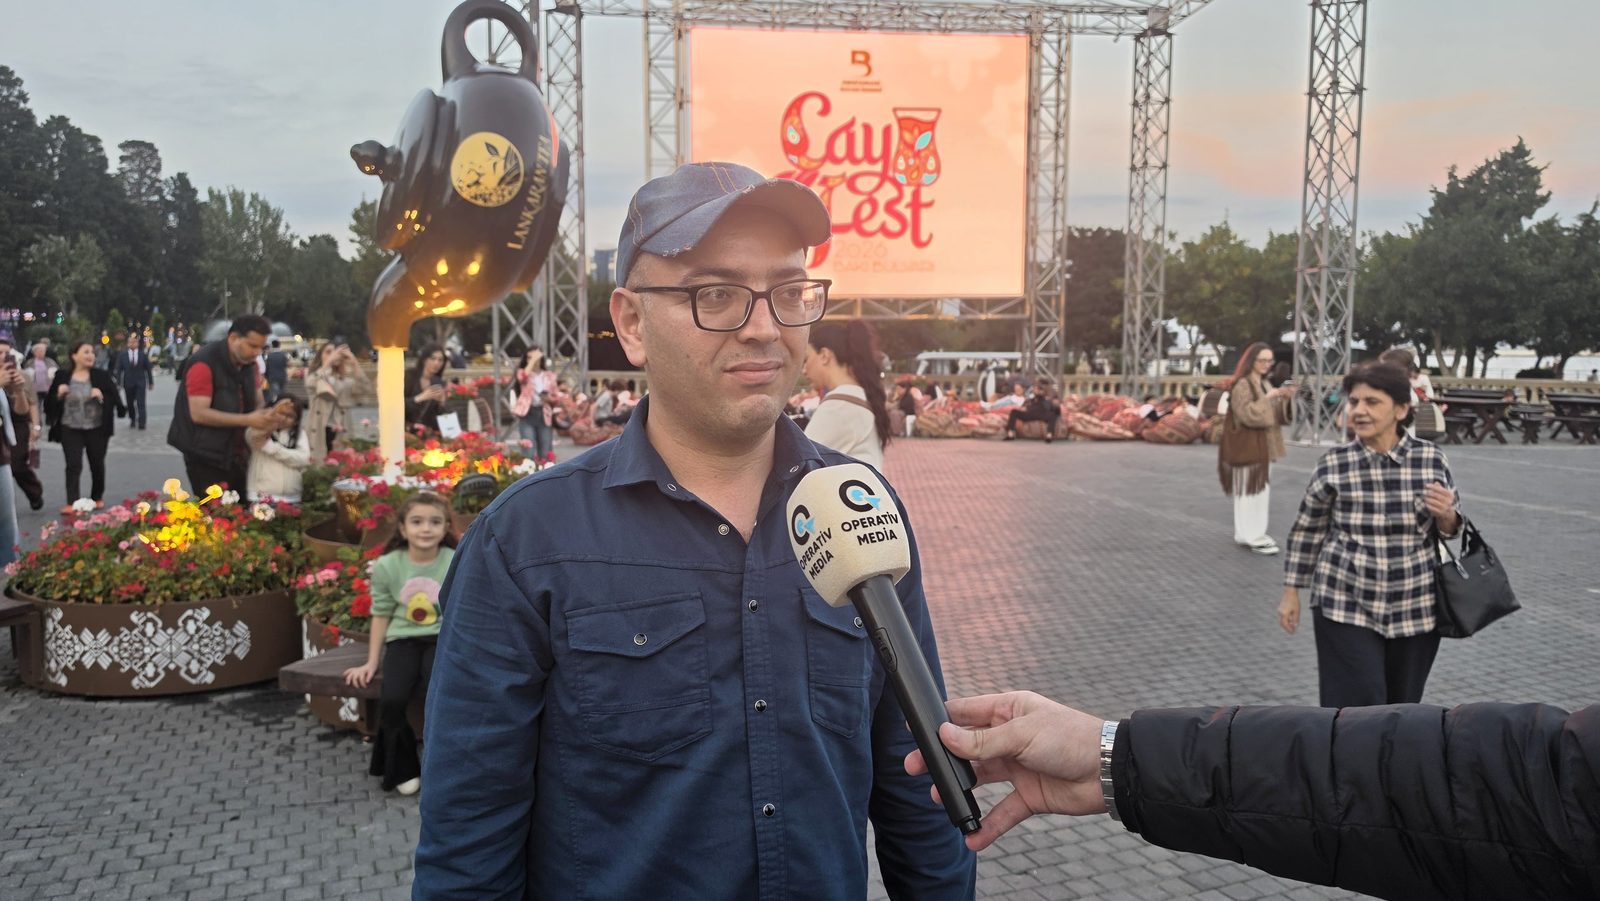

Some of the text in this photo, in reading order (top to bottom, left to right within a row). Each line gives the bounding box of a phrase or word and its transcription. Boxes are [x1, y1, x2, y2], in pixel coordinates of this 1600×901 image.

[834, 239, 888, 258] 2026
[841, 511, 899, 533] OPERATİV
[857, 527, 898, 546] MEDİA
[800, 527, 832, 570] OPERATİV
[809, 550, 834, 580] MEDİA
